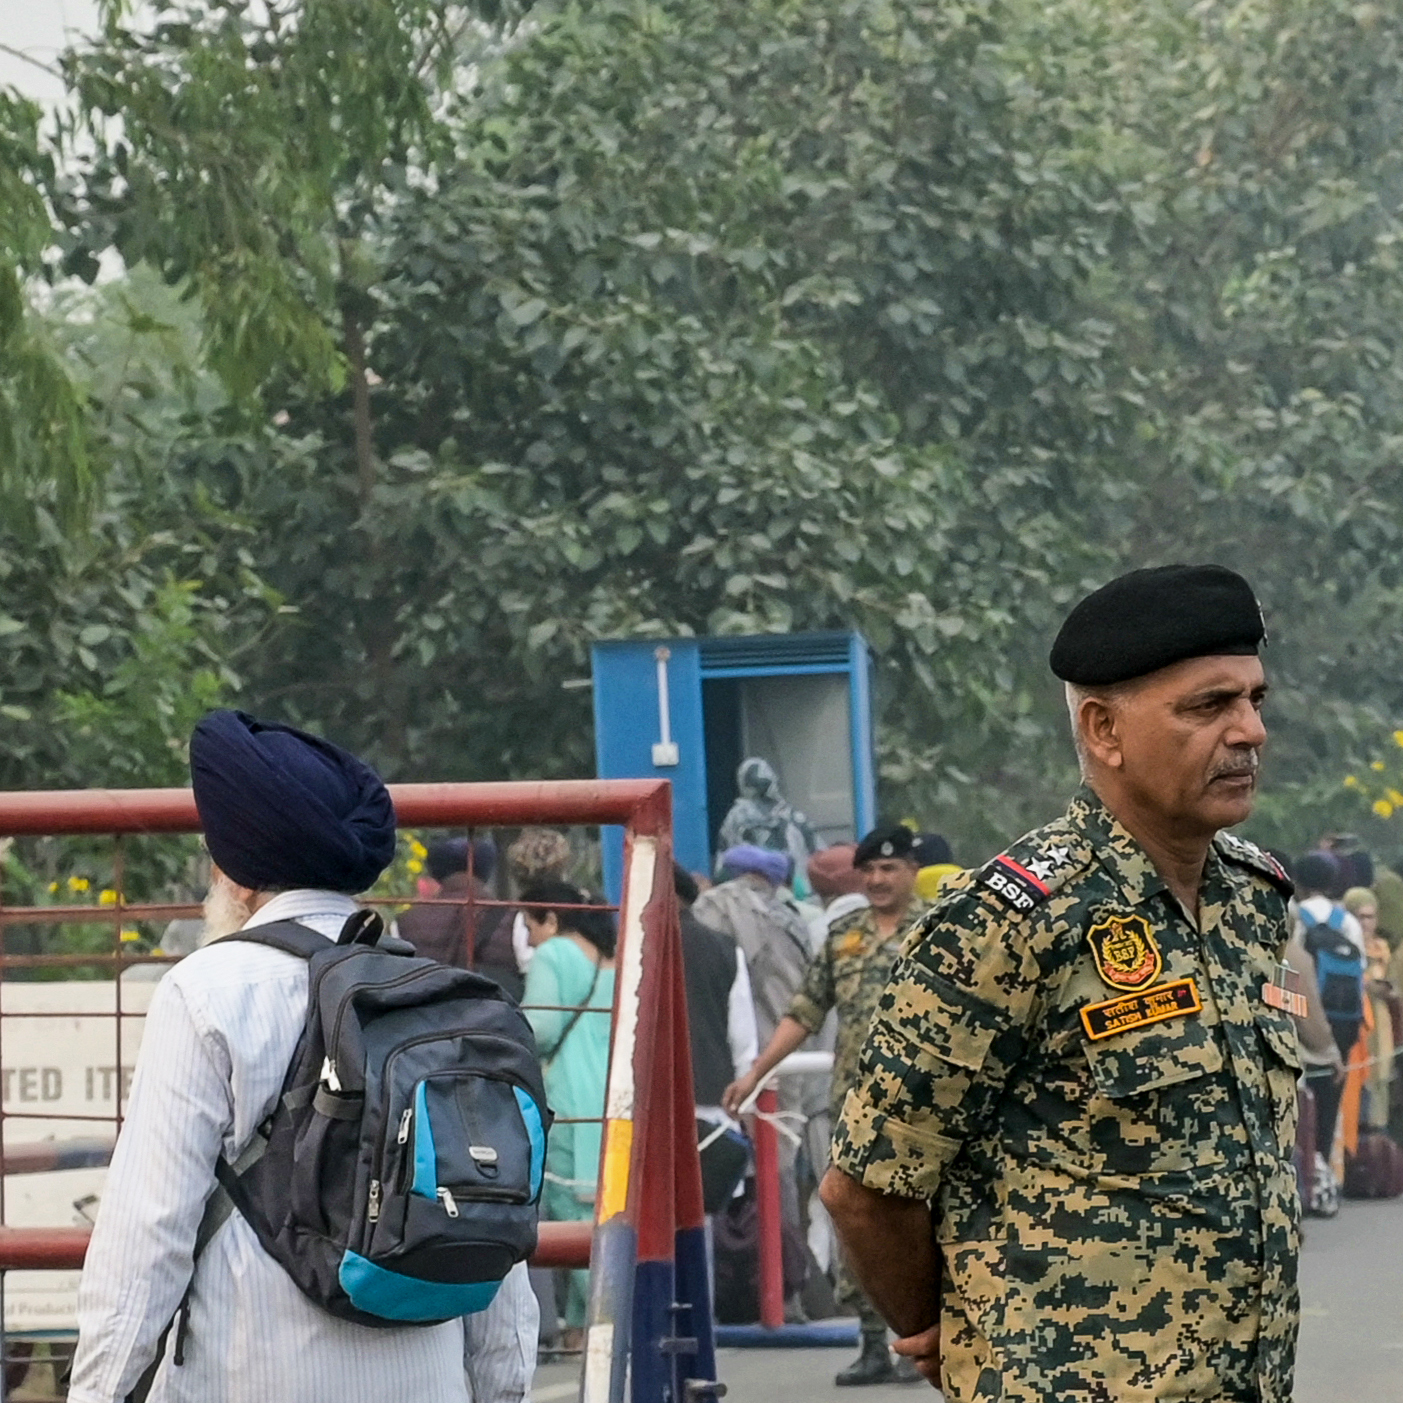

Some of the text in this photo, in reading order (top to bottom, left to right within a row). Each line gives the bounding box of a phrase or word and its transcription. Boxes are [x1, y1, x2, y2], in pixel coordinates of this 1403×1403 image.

[984, 871, 1035, 909] BSF
[1113, 946, 1135, 962] BSF
[1104, 1002, 1179, 1030] SATISH KUMAR
